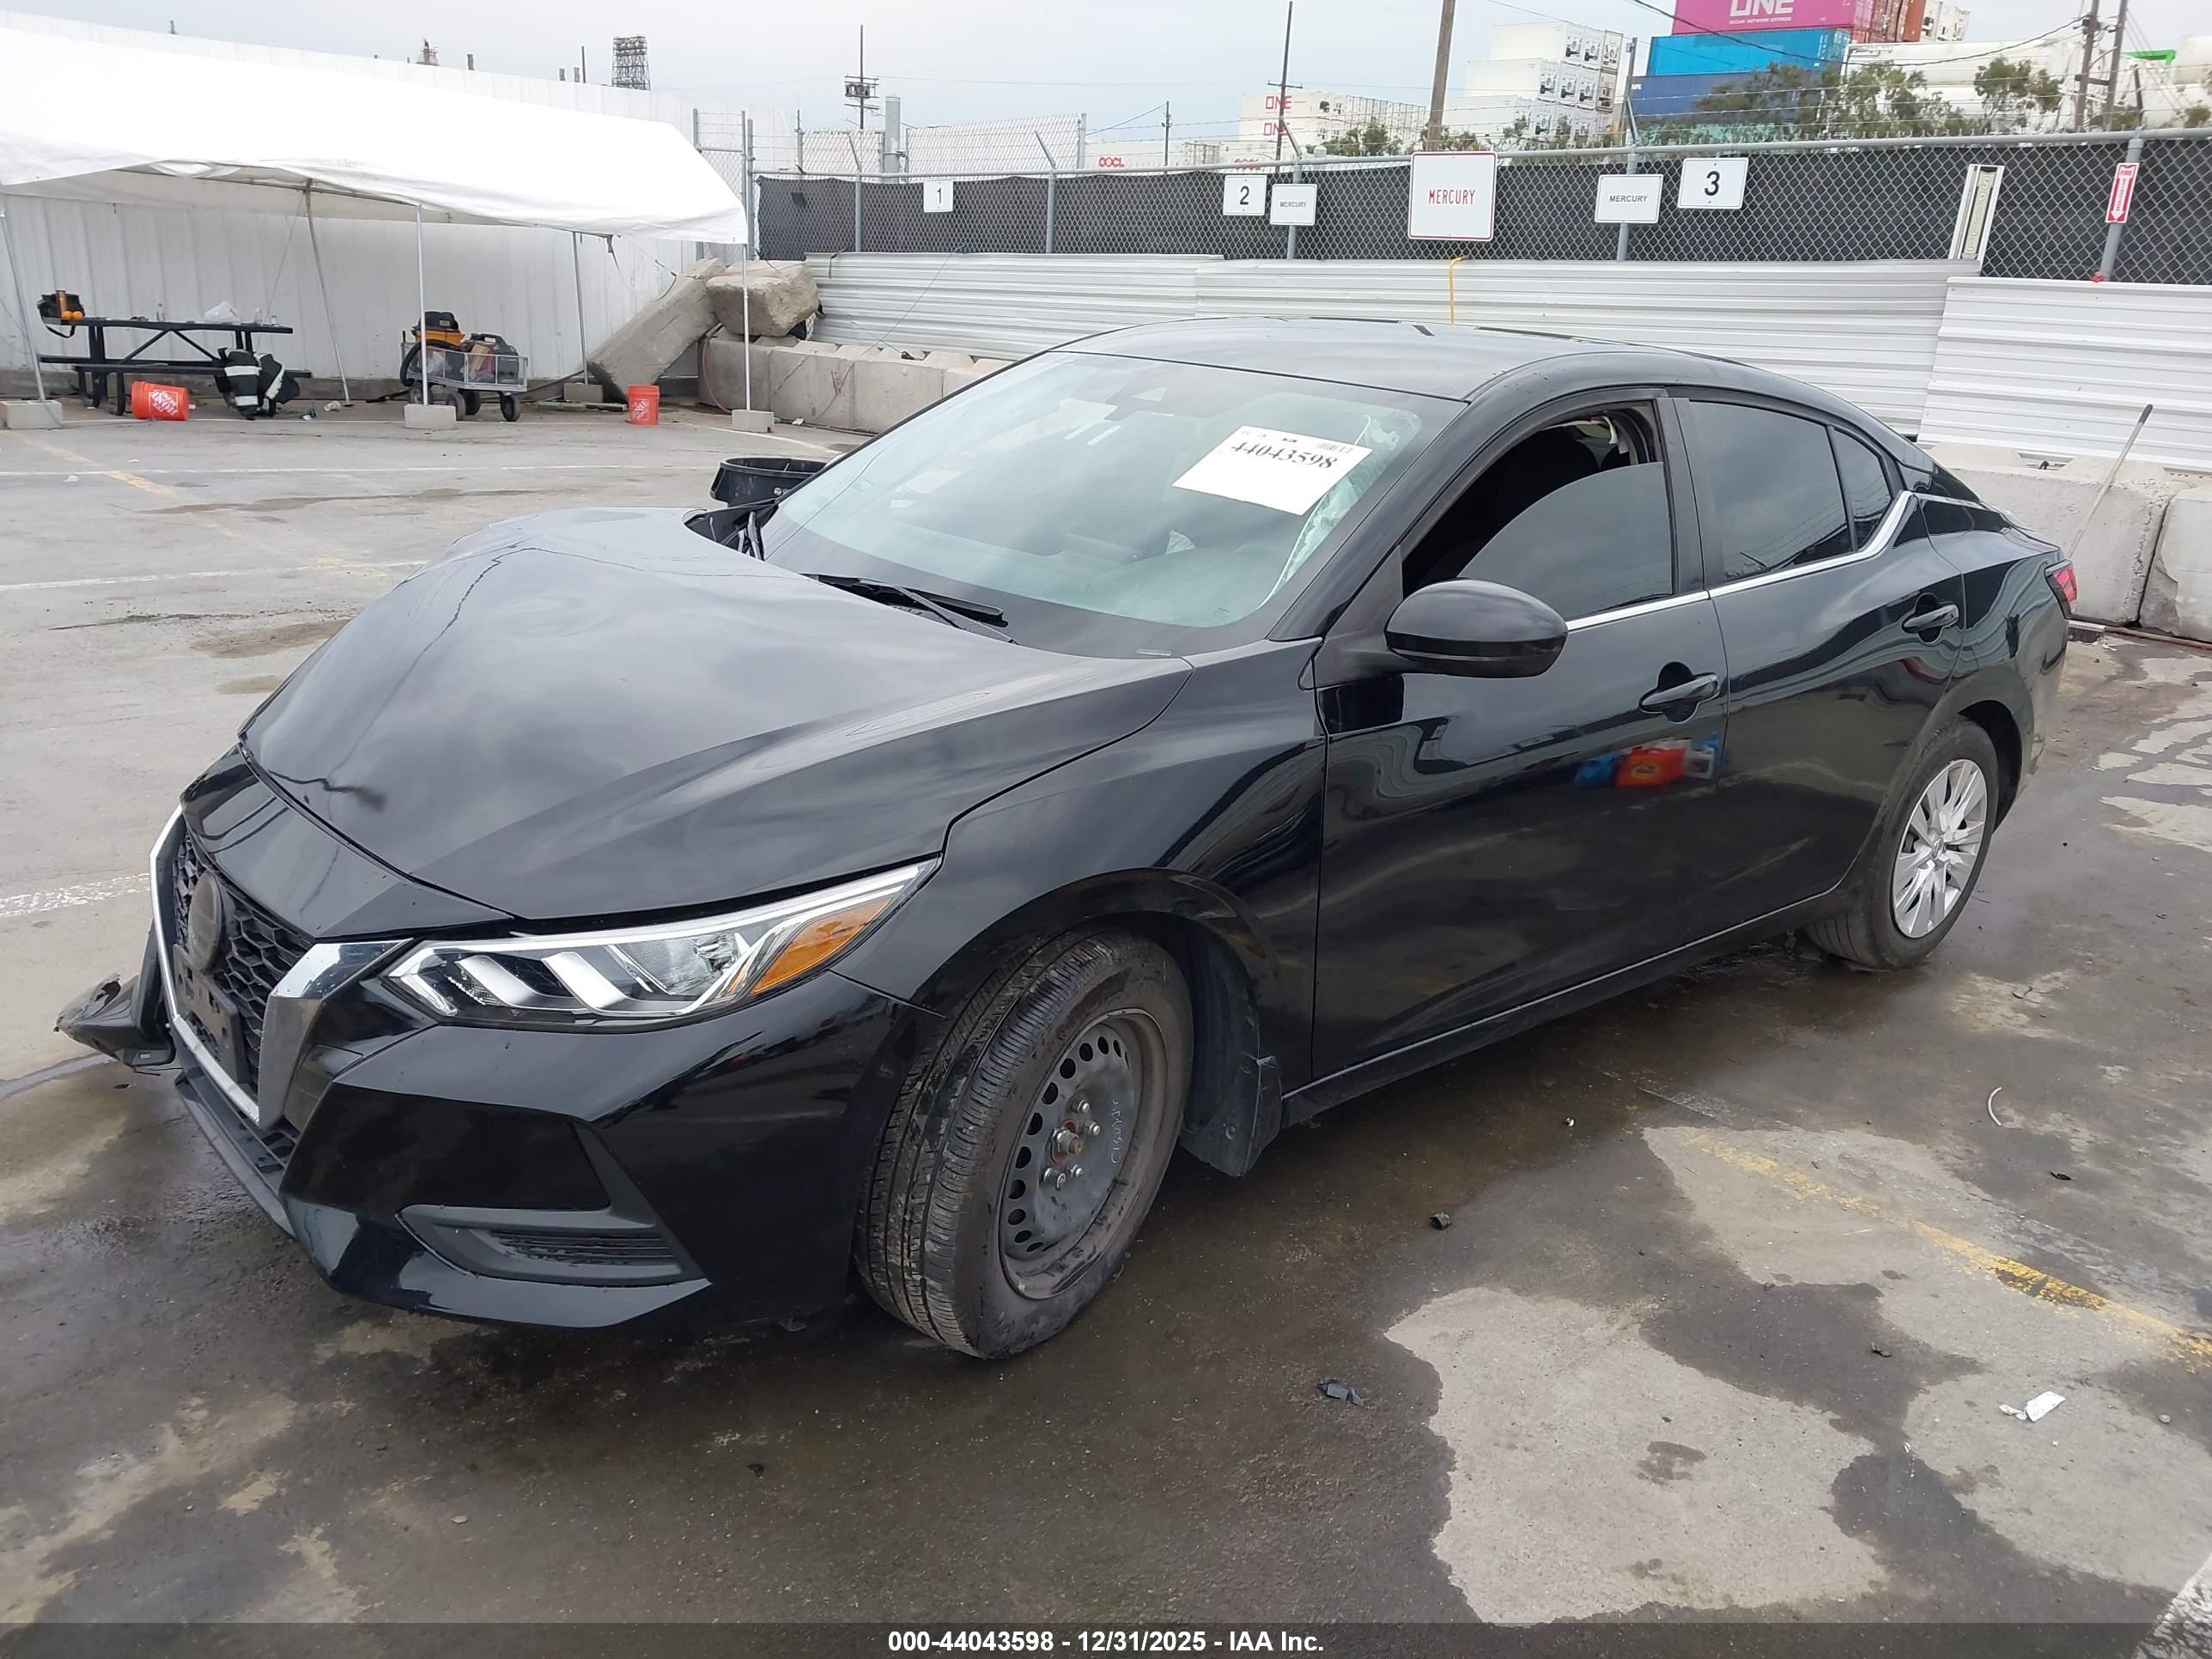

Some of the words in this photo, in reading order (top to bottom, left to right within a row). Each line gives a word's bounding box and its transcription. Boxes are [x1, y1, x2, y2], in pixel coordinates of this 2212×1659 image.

[1265, 95, 1292, 109] ONE
[1704, 171, 1720, 196] 3
[936, 186, 942, 204] 1
[1239, 185, 1249, 205] 2
[1428, 189, 1476, 204] MERCURY
[1231, 441, 1338, 469] 44043598
